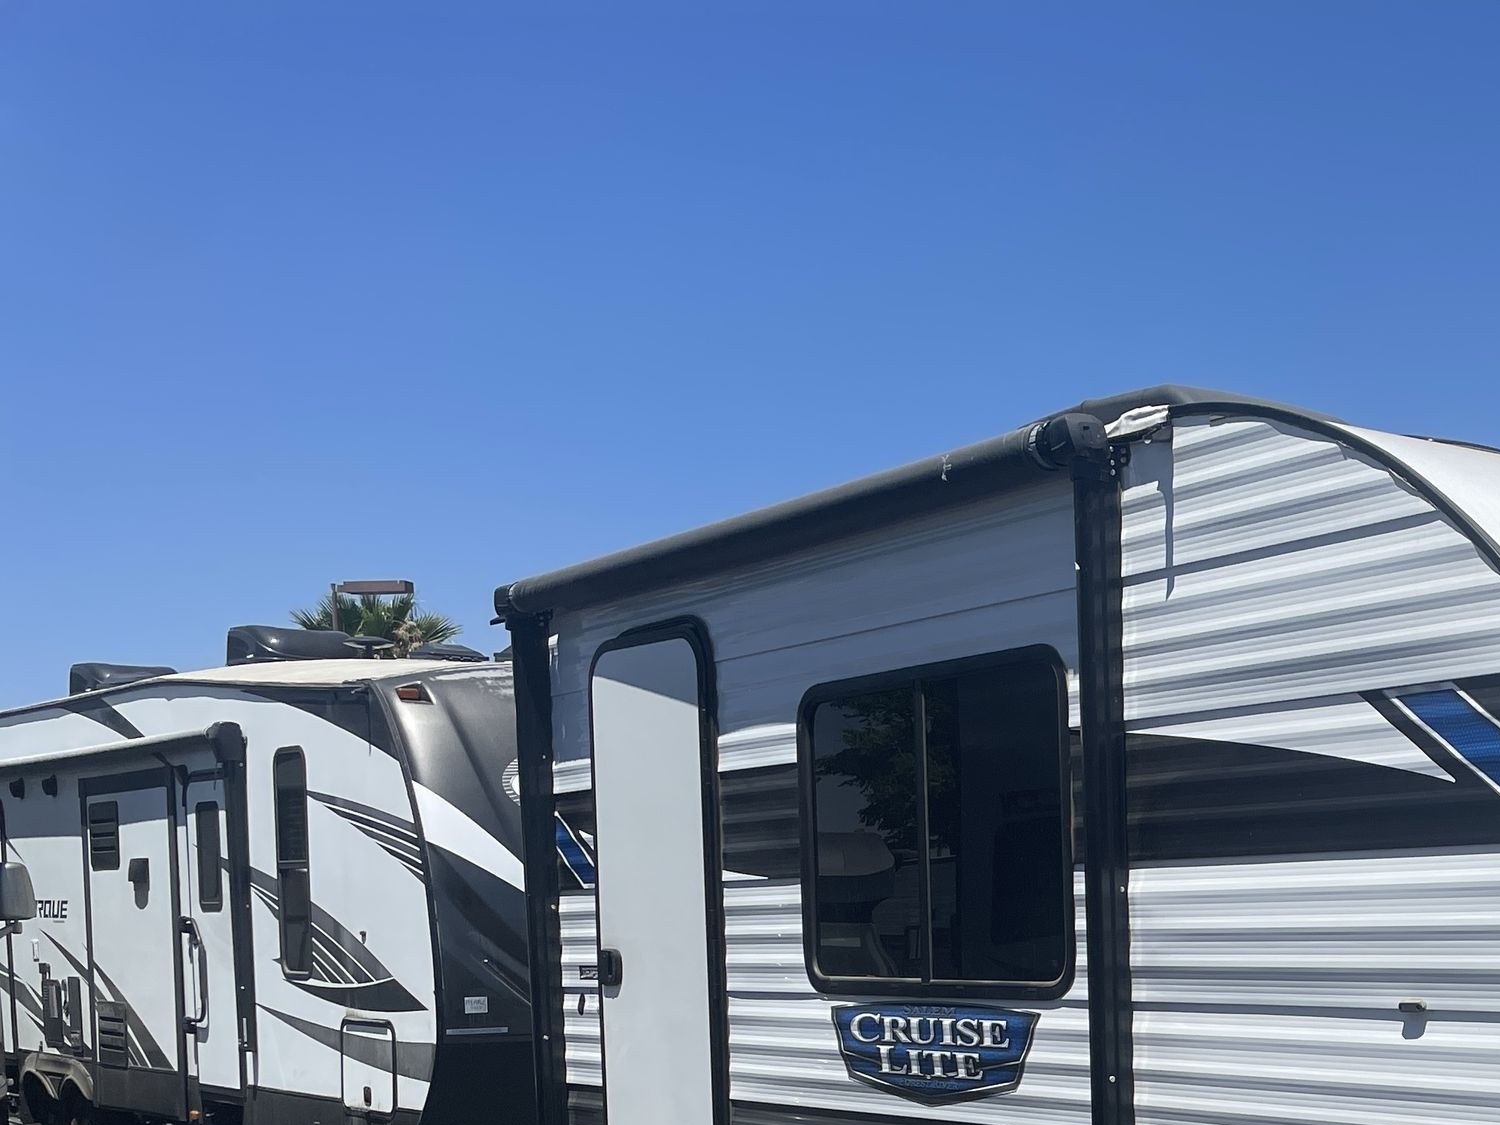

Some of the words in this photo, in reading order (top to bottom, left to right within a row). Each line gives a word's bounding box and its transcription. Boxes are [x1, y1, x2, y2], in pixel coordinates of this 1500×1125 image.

[37, 900, 68, 918] RQUE
[850, 1013, 1010, 1048] CRUISE
[876, 1044, 984, 1080] LITE
